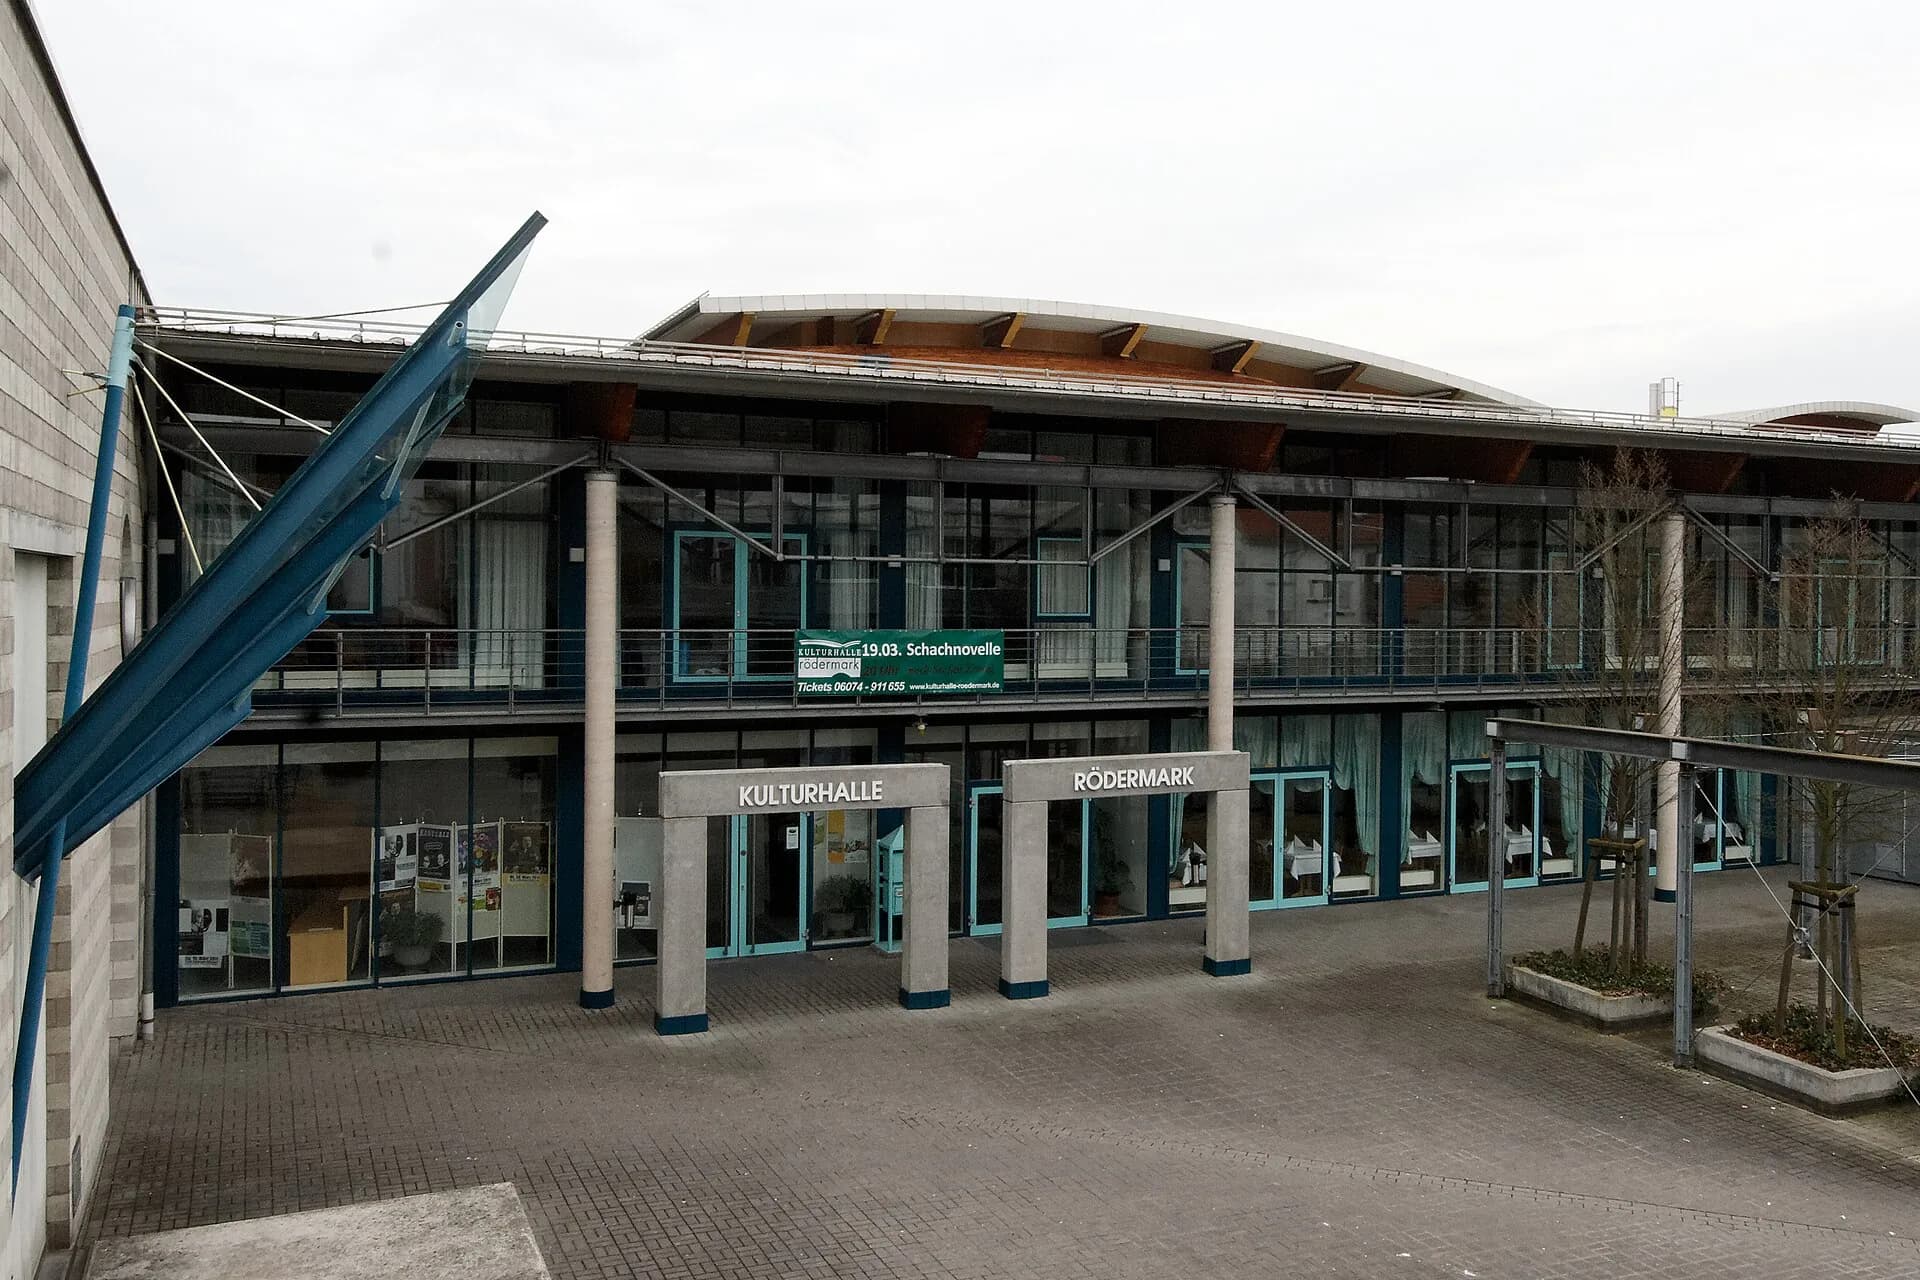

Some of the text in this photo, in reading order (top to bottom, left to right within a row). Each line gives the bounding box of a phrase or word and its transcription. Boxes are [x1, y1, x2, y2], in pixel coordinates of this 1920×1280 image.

[799, 648, 861, 657] KULTURHALLE
[862, 642, 1001, 657] 19.03. Schachnovelle
[799, 659, 859, 671] rödermark
[797, 682, 832, 692] Tickets
[834, 682, 863, 692] 06074
[909, 682, 1000, 691] www.kulturhalle-roedermark.de
[1073, 765, 1195, 792] RÖDERMARK
[739, 780, 883, 807] KULTURHALLE
